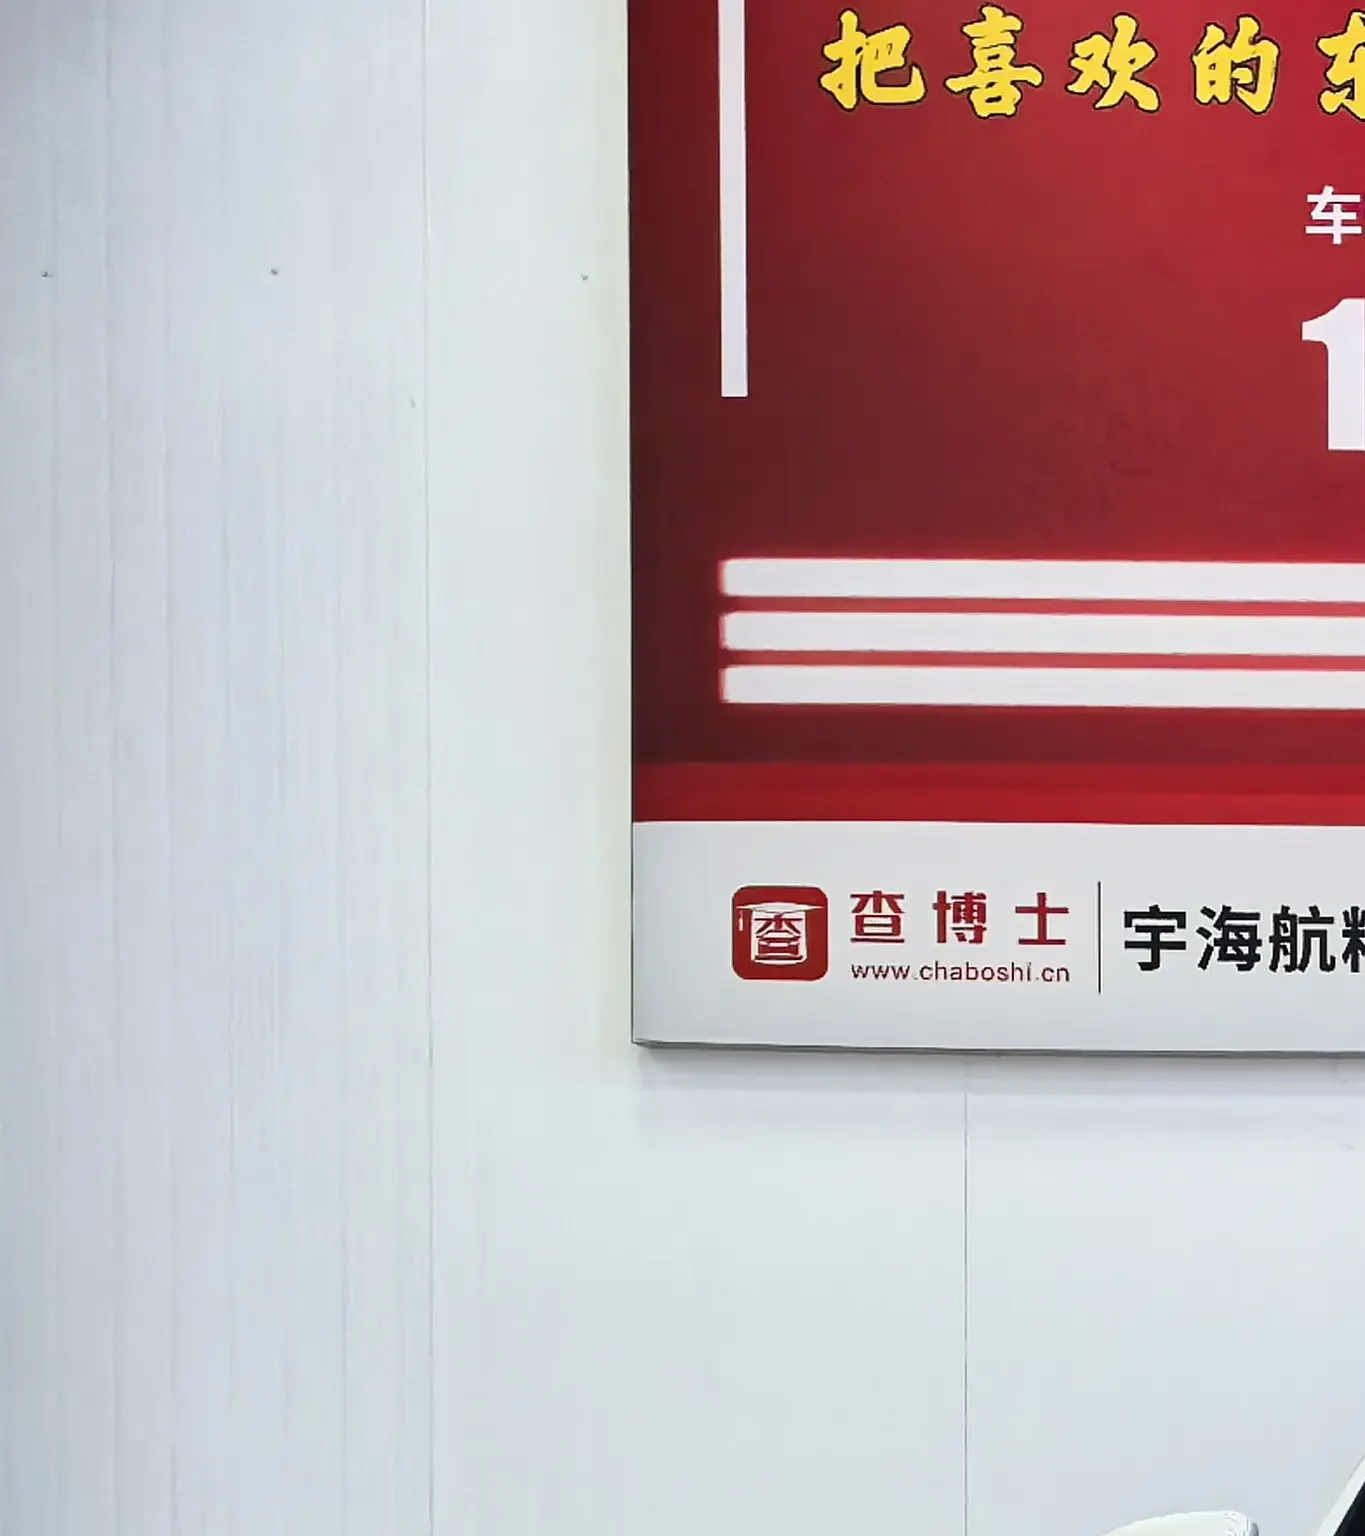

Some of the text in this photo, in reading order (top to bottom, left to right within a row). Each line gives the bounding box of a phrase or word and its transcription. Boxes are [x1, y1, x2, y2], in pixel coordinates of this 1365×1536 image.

[850, 890, 1070, 945] 查博士
[851, 961, 1070, 983] www.chaboshi.cn
